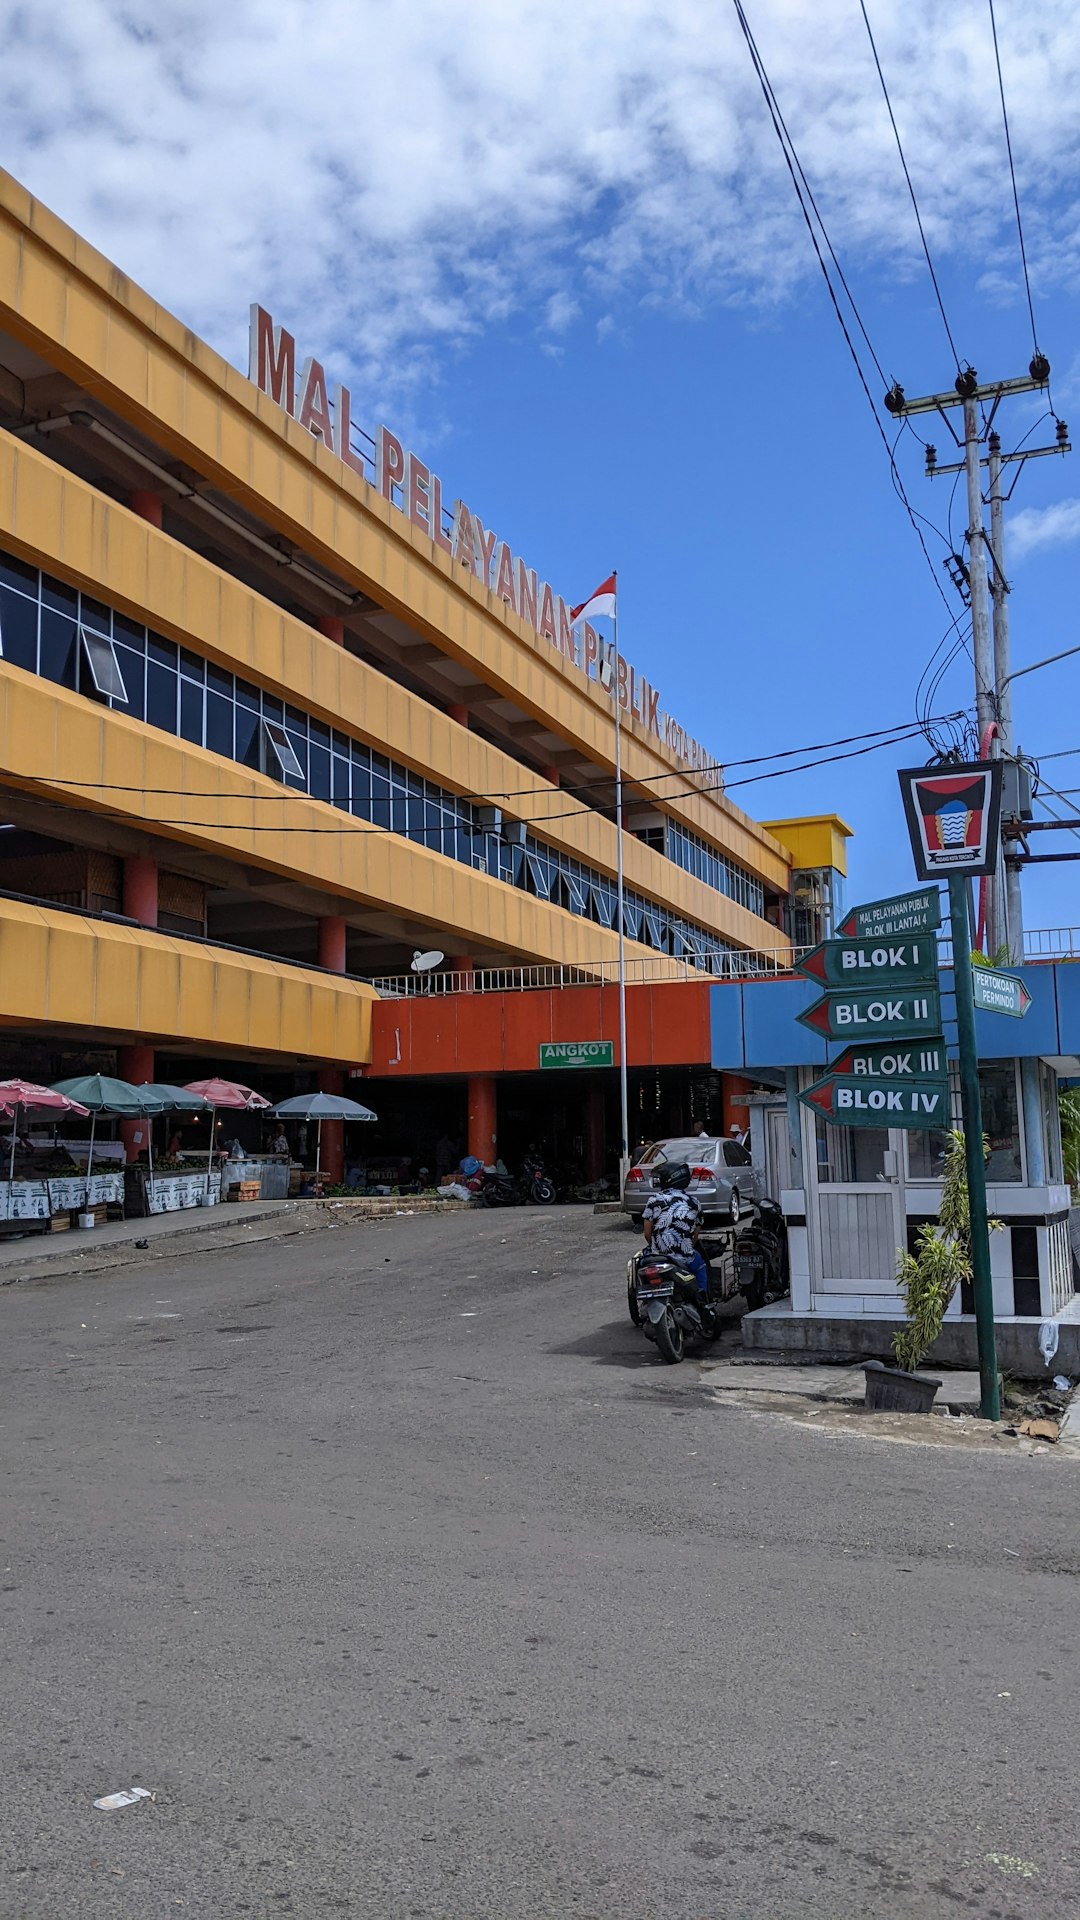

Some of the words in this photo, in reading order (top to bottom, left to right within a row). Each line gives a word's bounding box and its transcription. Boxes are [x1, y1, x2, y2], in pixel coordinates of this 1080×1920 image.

[250, 302, 365, 480] MAL
[376, 423, 578, 669] PELAYANAN
[662, 711, 689, 761] KOTA
[860, 911, 872, 925] MAL
[873, 902, 908, 921] PELAYANAN
[909, 896, 930, 912] PUBLIK
[865, 925, 884, 937] BLOK
[894, 915, 921, 931] LANTAI
[922, 913, 927, 924] 4
[841, 946, 907, 969] BLOK
[912, 945, 919, 964] I
[976, 972, 1015, 994] PERTOKOAN
[982, 989, 1014, 1009] PERMINDO
[836, 1000, 905, 1025] BLOK
[913, 999, 928, 1019] II
[544, 1043, 609, 1057] ANGKOT
[853, 1053, 913, 1076] BLOK
[920, 1051, 939, 1072] III
[837, 1088, 904, 1111] BLOK
[911, 1092, 939, 1113] IV
